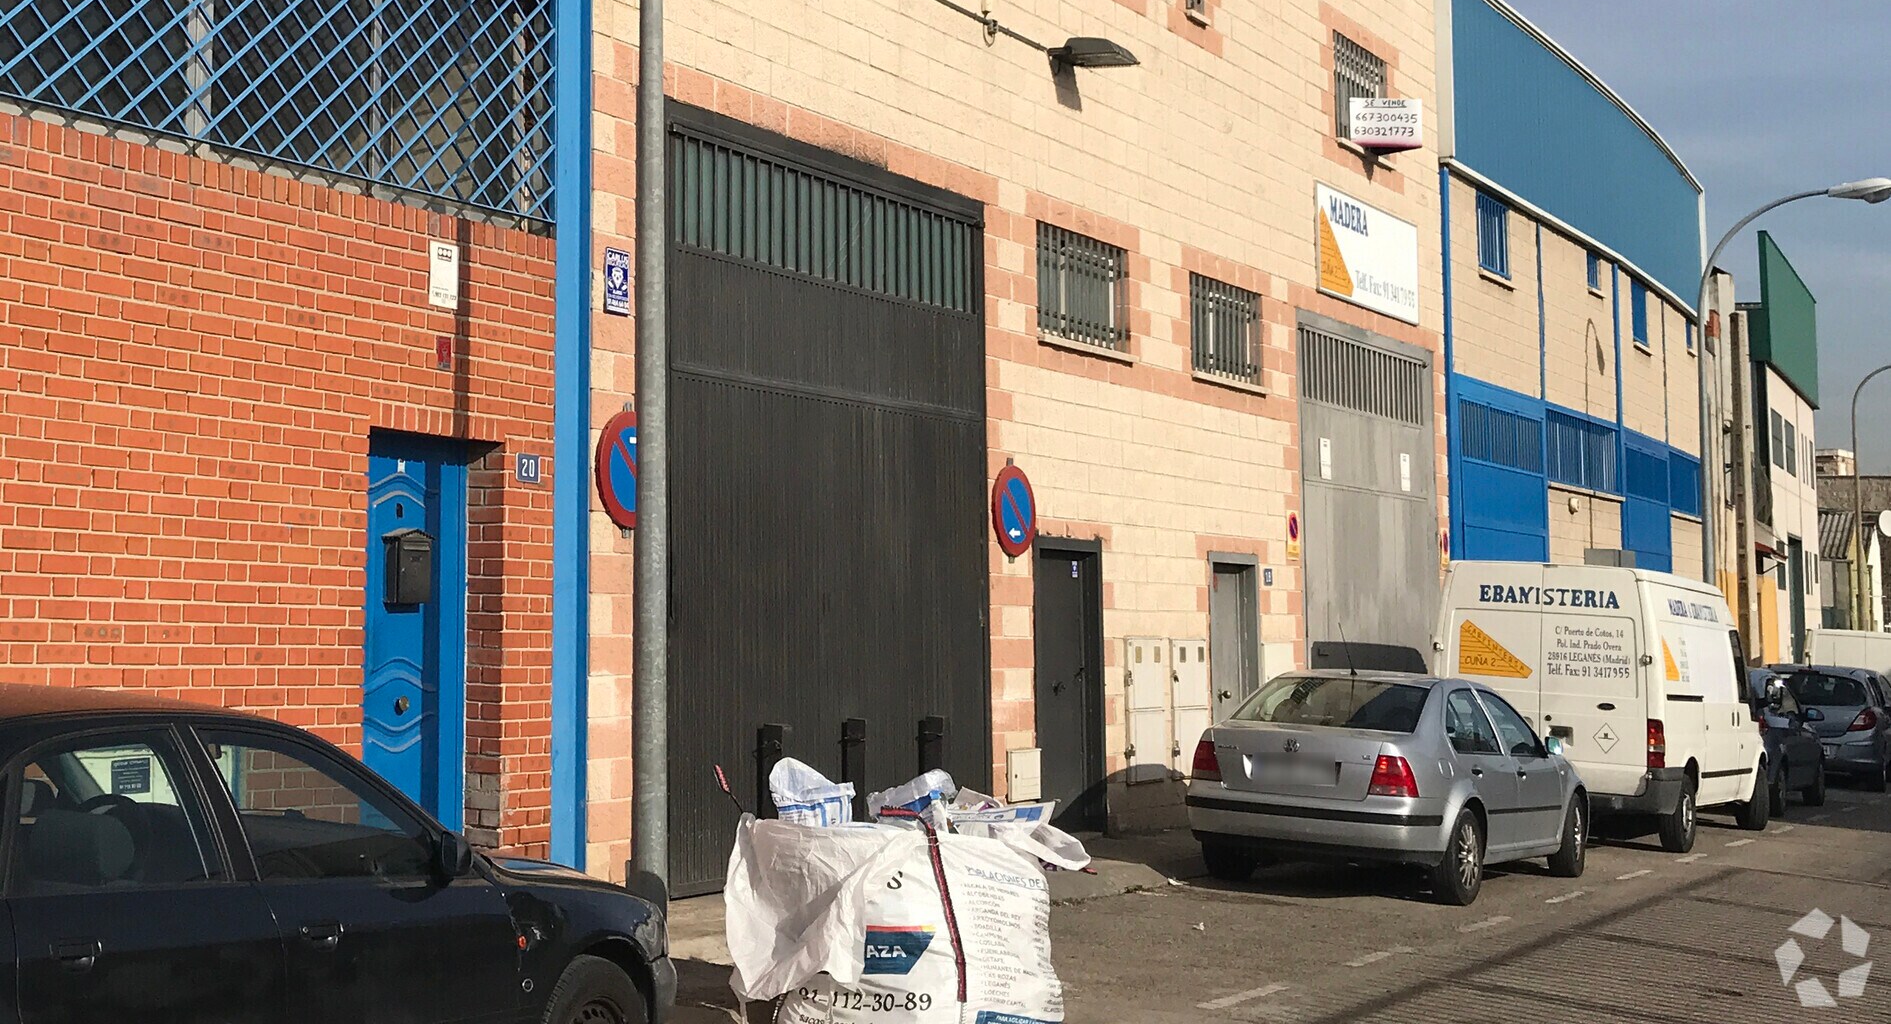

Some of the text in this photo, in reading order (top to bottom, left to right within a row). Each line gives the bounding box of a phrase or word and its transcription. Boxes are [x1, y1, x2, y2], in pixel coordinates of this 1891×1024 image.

[1364, 99, 1406, 107] SE VENDE
[1355, 112, 1418, 124] 667300435
[1354, 126, 1415, 137] 630321773
[1329, 194, 1369, 238] MADERA
[521, 458, 536, 478] 20
[1564, 626, 1585, 636] Puerto
[1585, 627, 1593, 636] de
[1616, 629, 1624, 638] 14
[1583, 640, 1601, 650] Prado
[1464, 654, 1497, 667] CUÑA 2
[1602, 654, 1631, 665] (Madrid)
[1547, 663, 1563, 676] Telf.
[1565, 664, 1580, 677] Fax:
[1581, 666, 1591, 677] 91
[1028, 878, 1041, 888] DE
